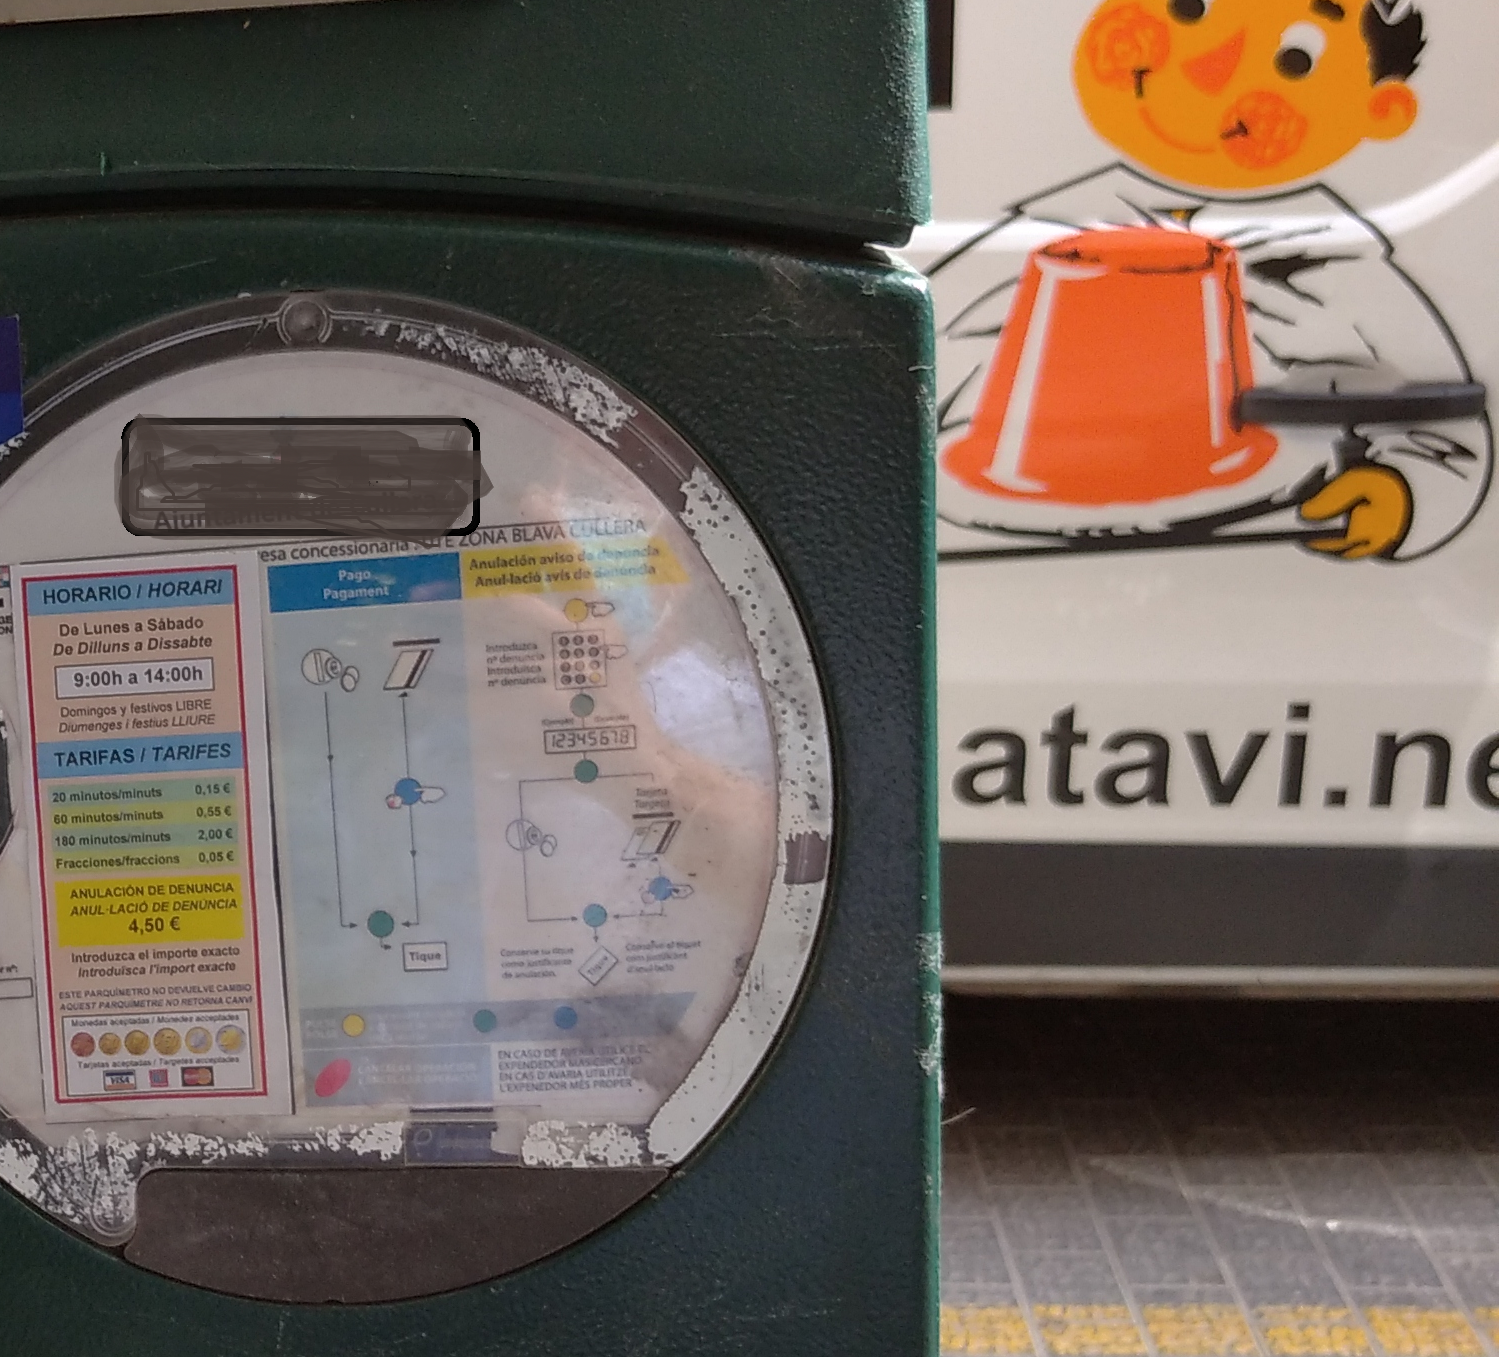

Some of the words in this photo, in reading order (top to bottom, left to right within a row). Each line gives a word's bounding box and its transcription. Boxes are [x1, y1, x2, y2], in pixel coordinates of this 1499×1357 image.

[459, 527, 507, 546] ZONA
[512, 524, 565, 543] BLAVA
[569, 518, 647, 538] CULLERA
[470, 553, 536, 571] Anulación
[539, 551, 574, 565] aviso
[338, 569, 371, 583] Pago
[43, 584, 131, 605] HORARIO
[148, 578, 223, 599] HORARI
[322, 586, 389, 601] Pagament
[59, 623, 79, 637] De
[84, 622, 130, 635] Lunes
[134, 622, 143, 632] a
[147, 616, 204, 632] Sábado
[53, 643, 74, 656] De
[77, 640, 130, 655] Dilluns
[134, 641, 143, 651] a
[147, 635, 213, 651] Dissabte
[73, 669, 123, 688] 9:00h
[128, 672, 138, 685] a
[144, 666, 203, 684] 14:00h
[60, 706, 117, 719] Domingos
[120, 705, 127, 716] y
[130, 702, 173, 715] festivos
[176, 699, 212, 712] LIBRE
[58, 719, 122, 734] Diumenges
[132, 717, 169, 729] festius
[171, 713, 216, 727] LLIURE
[551, 729, 630, 749] 12345678
[54, 748, 135, 767] TARIFAS
[152, 742, 231, 762] TARIFES
[53, 792, 67, 803] 20
[70, 787, 163, 802] minutos/minuts
[195, 783, 220, 796] 0,15
[223, 782, 231, 794] €
[53, 814, 67, 825] 60
[71, 809, 164, 824] minutos/minuts
[196, 806, 221, 819] 0,55
[224, 805, 232, 816] €
[55, 835, 76, 846] 180
[79, 831, 172, 846] minutos/minuts
[198, 829, 223, 842] 2,00
[225, 828, 233, 839] €
[55, 854, 180, 869] Fracciones/fraccions
[198, 851, 224, 864] 0,05
[226, 850, 234, 862] €
[70, 884, 144, 899] ANULACIÓN
[147, 884, 166, 895] DE
[169, 882, 234, 894] DENUNCIA
[152, 901, 169, 912] DE
[128, 917, 164, 935] 4,50
[169, 916, 180, 931] €
[71, 950, 135, 963] Introduzca
[138, 949, 149, 960] el
[153, 946, 198, 962] importe
[201, 946, 240, 957] exacto
[408, 951, 442, 963] Tique
[149, 962, 195, 977] l'import
[199, 960, 236, 972] exacte
[59, 990, 82, 999] ESTE
[84, 986, 150, 998] PARQUÍMETRO
[152, 986, 166, 995] NO
[168, 984, 215, 995] DEVUELVE
[217, 983, 252, 993] CAMBIO
[59, 1001, 97, 1011] AQUEST
[165, 997, 180, 1007] NO
[181, 996, 224, 1007] RETORNA
[225, 995, 253, 1005] CANVI
[498, 1050, 513, 1059] EN
[514, 1049, 541, 1059] CASO
[544, 1048, 558, 1058] DE
[499, 1059, 567, 1071] EXPENDEDOR
[110, 1076, 131, 1085] VISA
[499, 1072, 513, 1081] EN
[515, 1071, 535, 1081] CAS
[593, 1078, 632, 1089] PROPER
